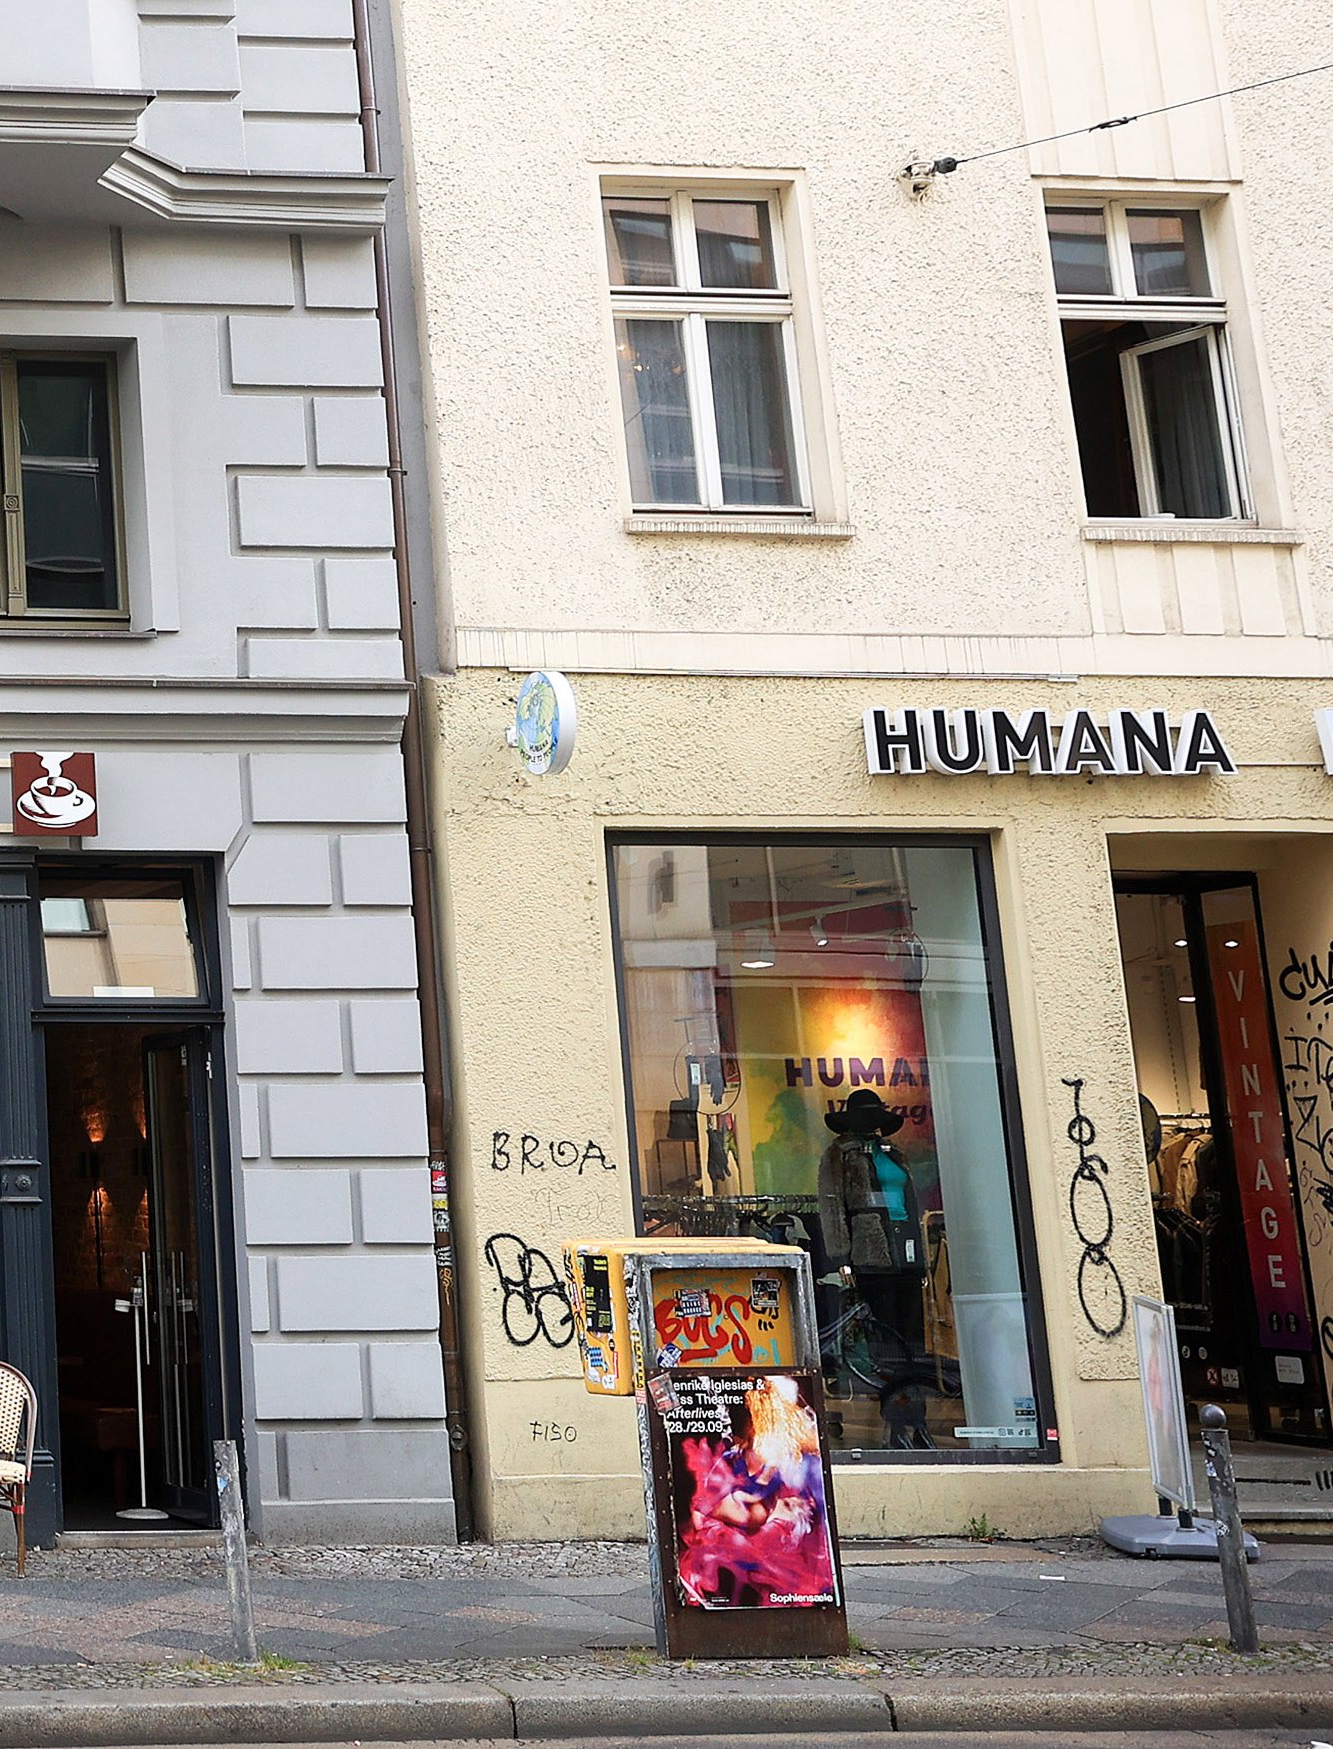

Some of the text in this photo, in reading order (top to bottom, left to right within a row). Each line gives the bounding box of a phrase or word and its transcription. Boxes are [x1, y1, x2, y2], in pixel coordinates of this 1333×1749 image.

[866, 707, 1238, 775] HUMANA
[1228, 969, 1287, 1290] VINTAGE
[672, 1378, 766, 1393] enrike Iglesias &
[677, 1393, 744, 1405] iss Theatre:
